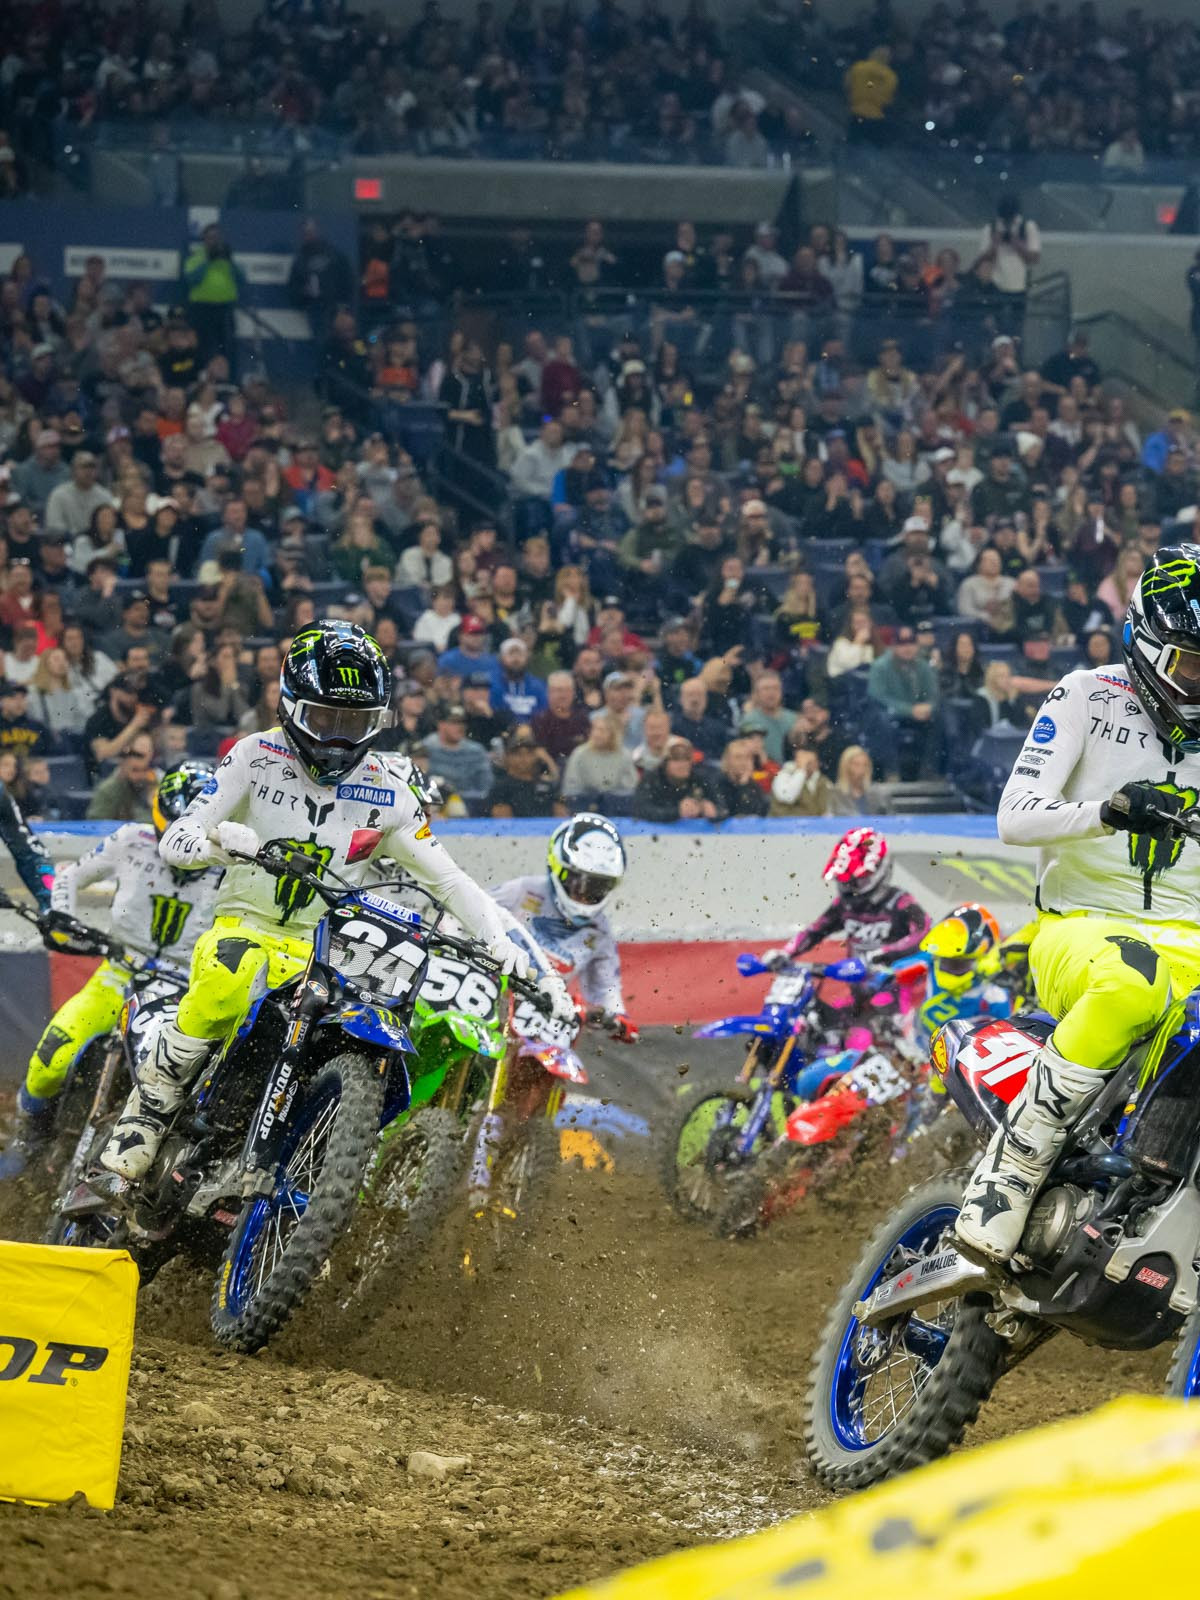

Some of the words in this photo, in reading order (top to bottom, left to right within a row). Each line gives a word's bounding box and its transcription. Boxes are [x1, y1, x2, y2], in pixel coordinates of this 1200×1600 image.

[353, 787, 393, 804] YAMAHA
[329, 920, 427, 997] 34
[418, 957, 499, 1018] 56
[260, 1061, 293, 1140] DUNLOP
[920, 1253, 959, 1276] YAMALUBE
